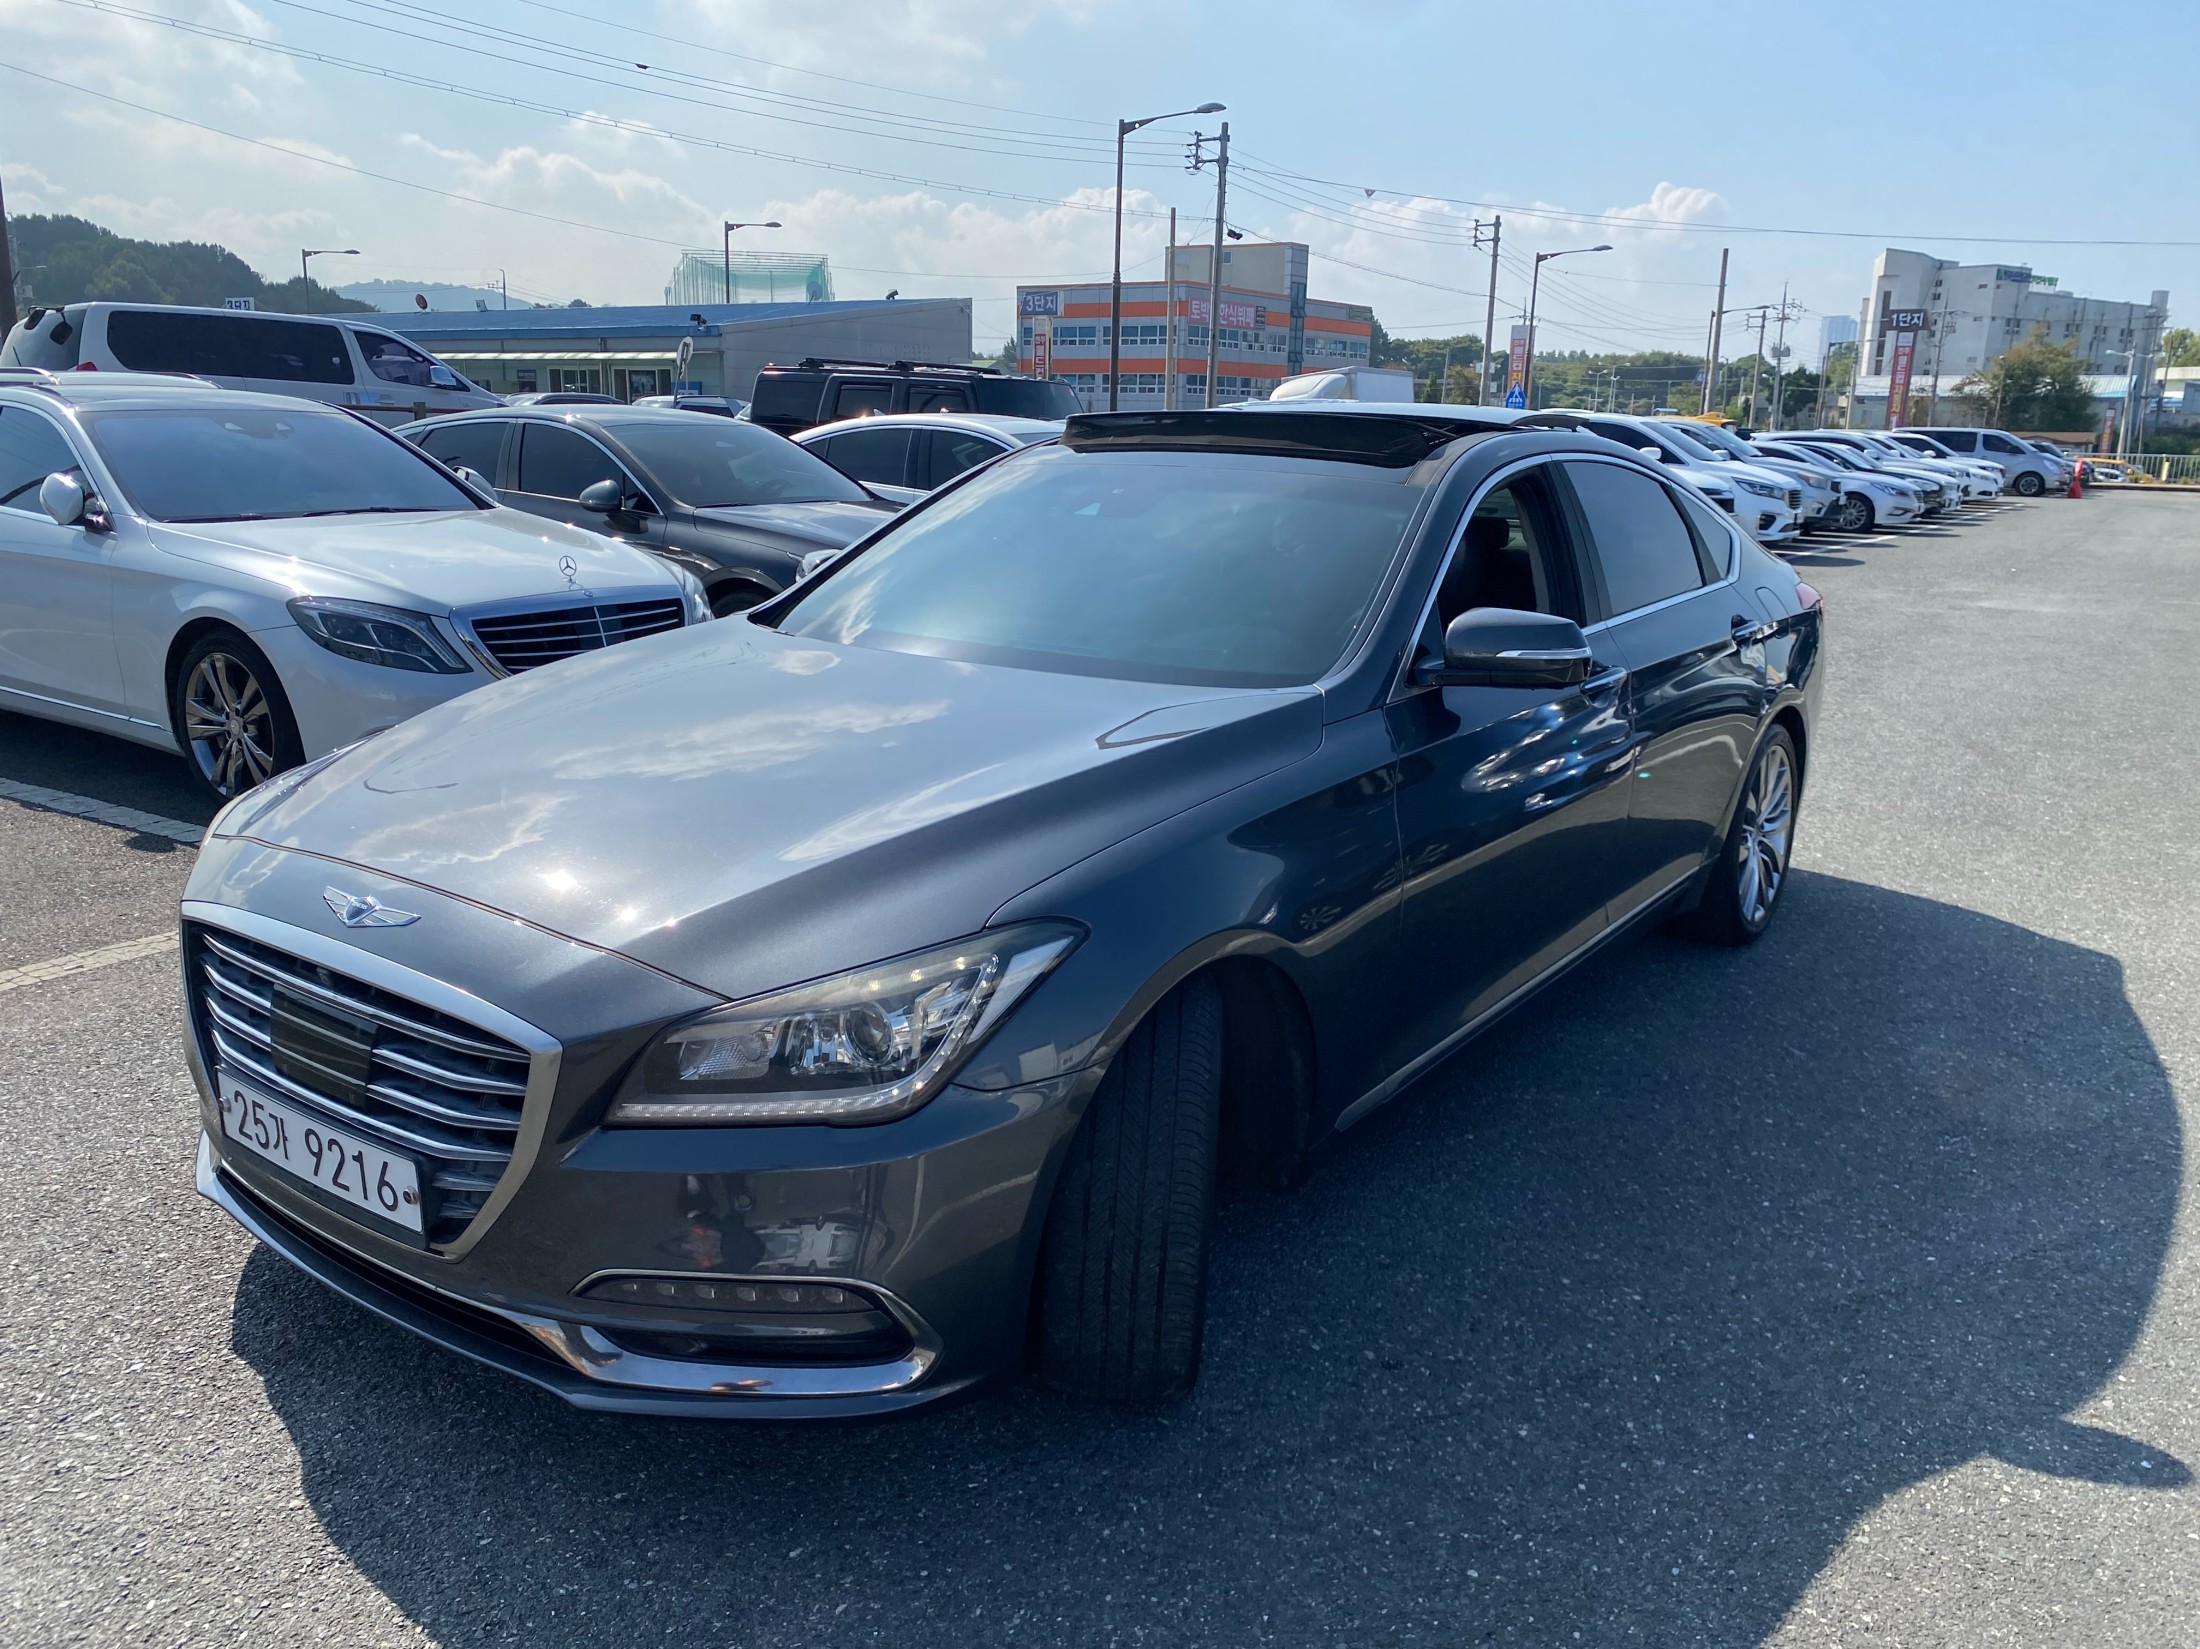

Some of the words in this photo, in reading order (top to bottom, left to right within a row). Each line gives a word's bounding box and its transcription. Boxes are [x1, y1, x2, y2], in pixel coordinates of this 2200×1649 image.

[1026, 295, 1056, 312] 3단지
[1892, 312, 1924, 327] 1단지
[234, 1090, 289, 1160] 25가
[304, 1128, 398, 1212] 9216
